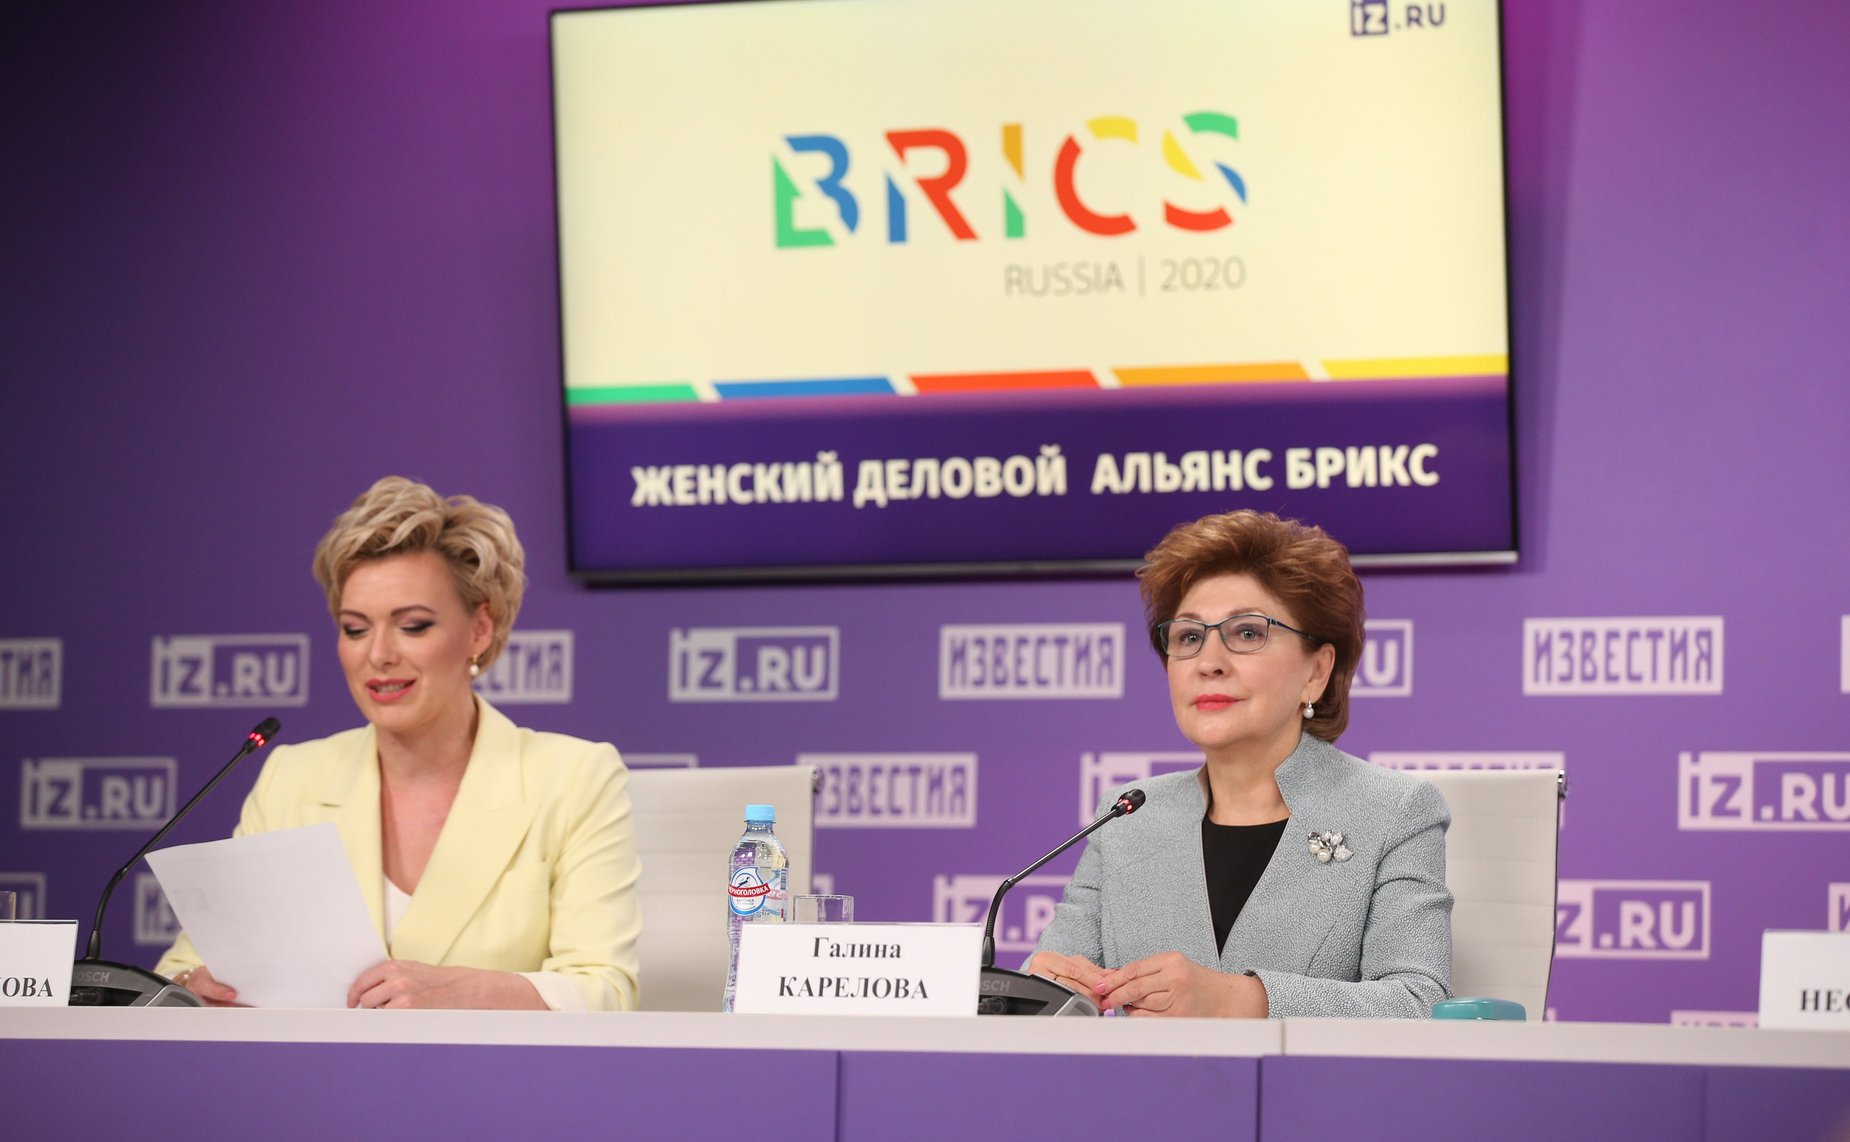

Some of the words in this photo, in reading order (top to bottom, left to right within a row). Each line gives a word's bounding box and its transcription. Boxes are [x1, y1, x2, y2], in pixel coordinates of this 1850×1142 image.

[772, 111, 1248, 249] BRICS
[1004, 261, 1126, 298] RUSSIA
[1160, 255, 1247, 293] 2020
[631, 450, 844, 507] ЖЕНСКИЙ
[853, 444, 1067, 508] ДЕЛОВОЙ
[1091, 448, 1274, 494] АЛЬЯНС
[1285, 444, 1440, 490] БРИКС
[948, 633, 1114, 687] ИЗВЕСТИЯ
[1534, 627, 1713, 684] ИЗВЕСТИЯ
[815, 765, 966, 817] ЗВЕСТИЯ
[813, 937, 901, 959] Галина
[0, 976, 53, 998] ОВА
[778, 976, 929, 999] КАРЕЛОВА
[981, 980, 1010, 992] SCH
